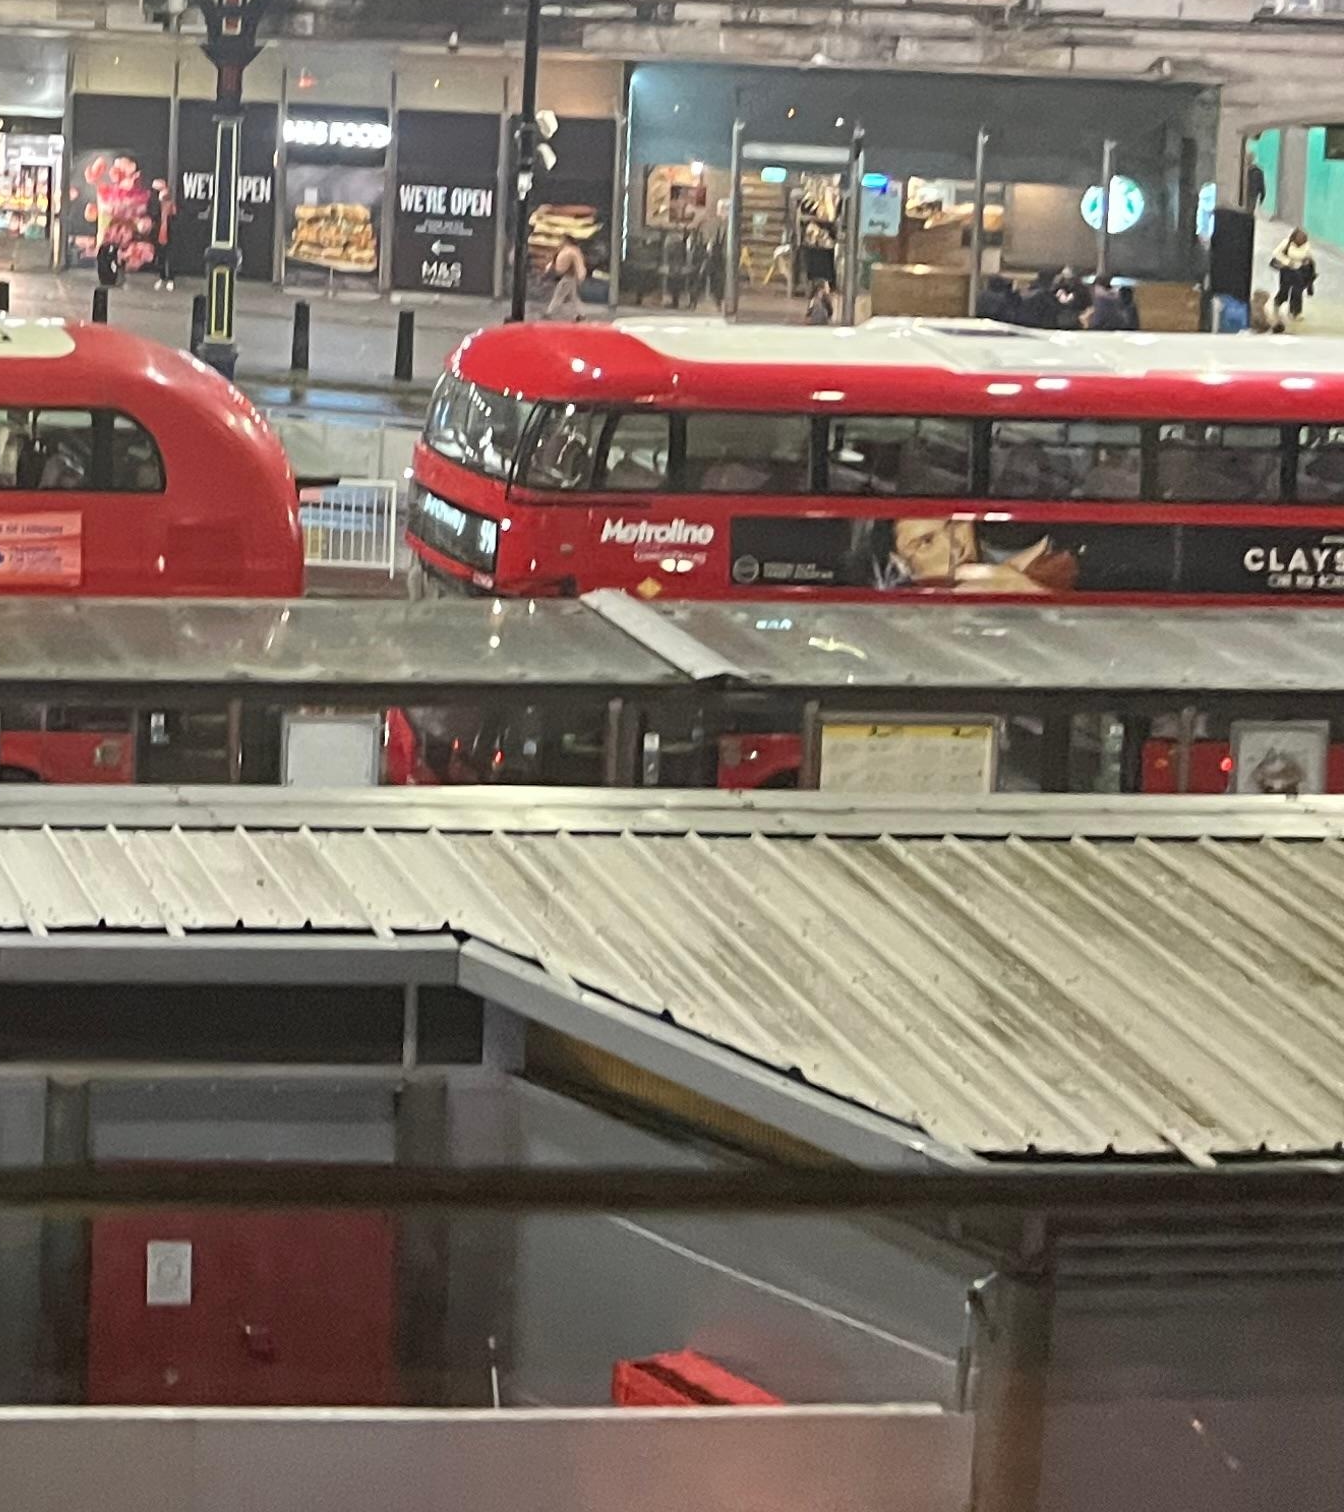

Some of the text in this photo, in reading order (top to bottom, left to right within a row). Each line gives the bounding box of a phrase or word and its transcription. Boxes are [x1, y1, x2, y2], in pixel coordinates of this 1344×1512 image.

[329, 122, 392, 148] FOOD
[399, 184, 493, 217] WE'RE OPEN
[600, 517, 714, 546] Metroline
